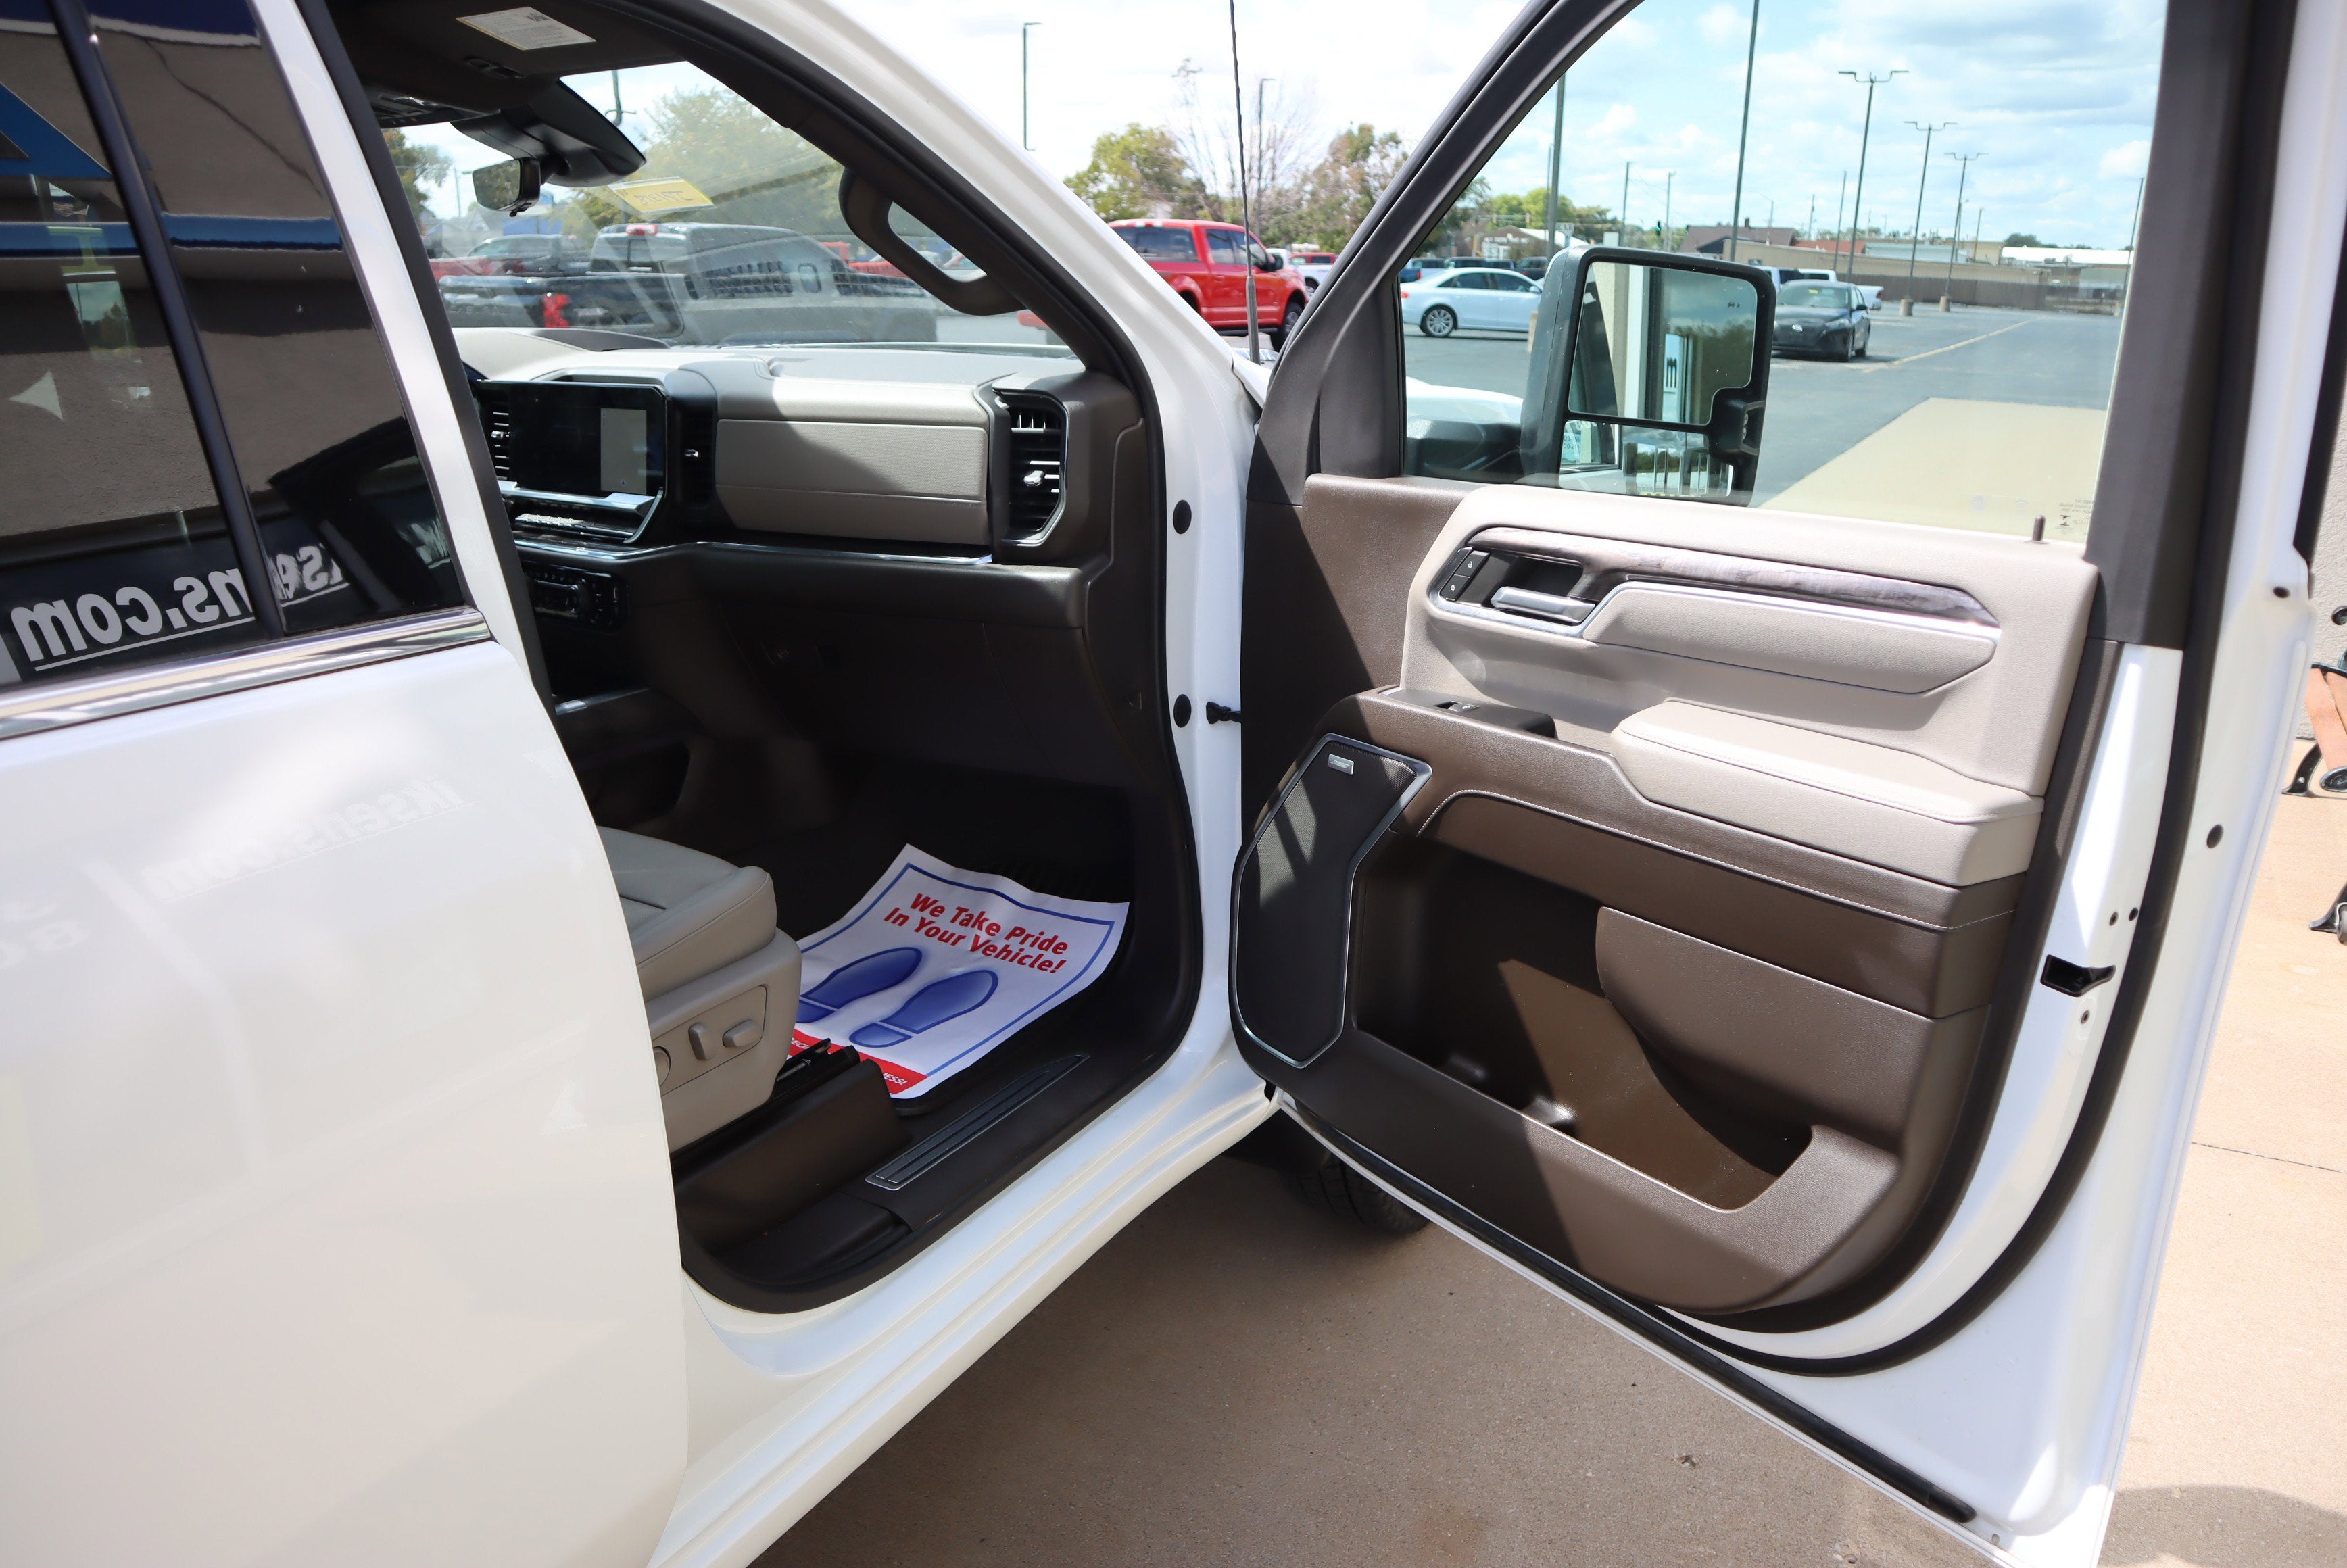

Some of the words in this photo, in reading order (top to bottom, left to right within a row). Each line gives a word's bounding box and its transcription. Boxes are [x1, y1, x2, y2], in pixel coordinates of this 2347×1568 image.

[884, 908, 910, 927] In
[915, 917, 966, 946] Your
[971, 934, 1066, 973] Vehicle!
[911, 893, 946, 918] We
[951, 907, 1002, 937] Take
[1005, 926, 1068, 955] Pride
